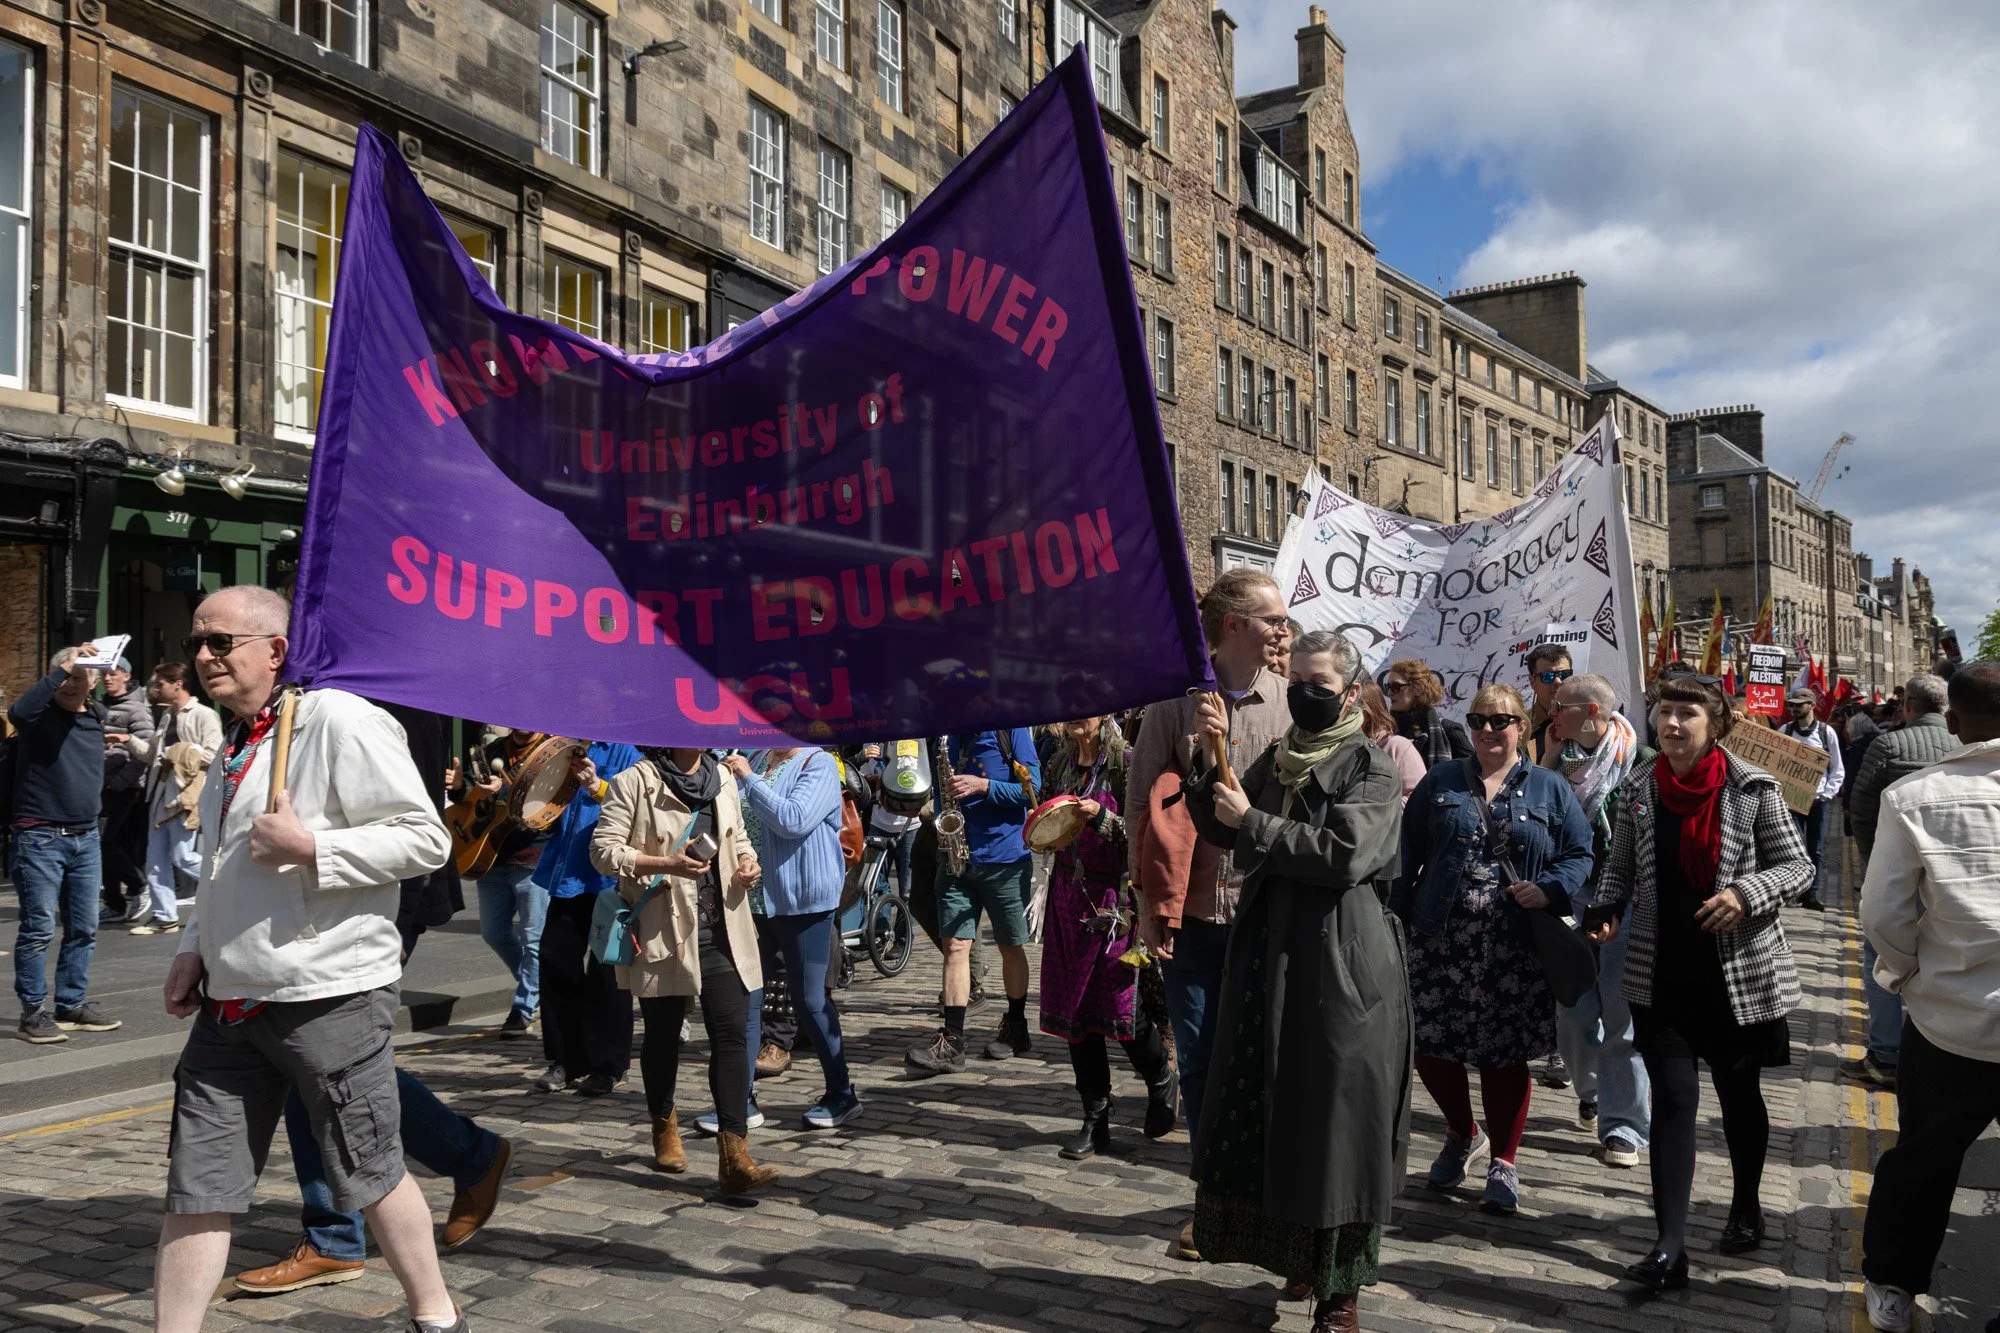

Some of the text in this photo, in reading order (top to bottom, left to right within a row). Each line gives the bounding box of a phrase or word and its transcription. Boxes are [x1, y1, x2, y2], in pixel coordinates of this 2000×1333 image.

[851, 245, 1068, 372] POWER
[580, 372, 904, 473] University of
[626, 458, 895, 541] Edinburgh
[387, 507, 1120, 645] SUPPORT EDUCATION
[1535, 630, 1588, 646] Arming
[1752, 654, 1784, 668] FREEDOM
[1749, 670, 1784, 685] PALESTINE
[1752, 686, 1776, 698] الحرية
[1748, 697, 1779, 709] لفلسطين
[1794, 744, 1809, 759] IS
[1776, 754, 1824, 786] WITHOUT
